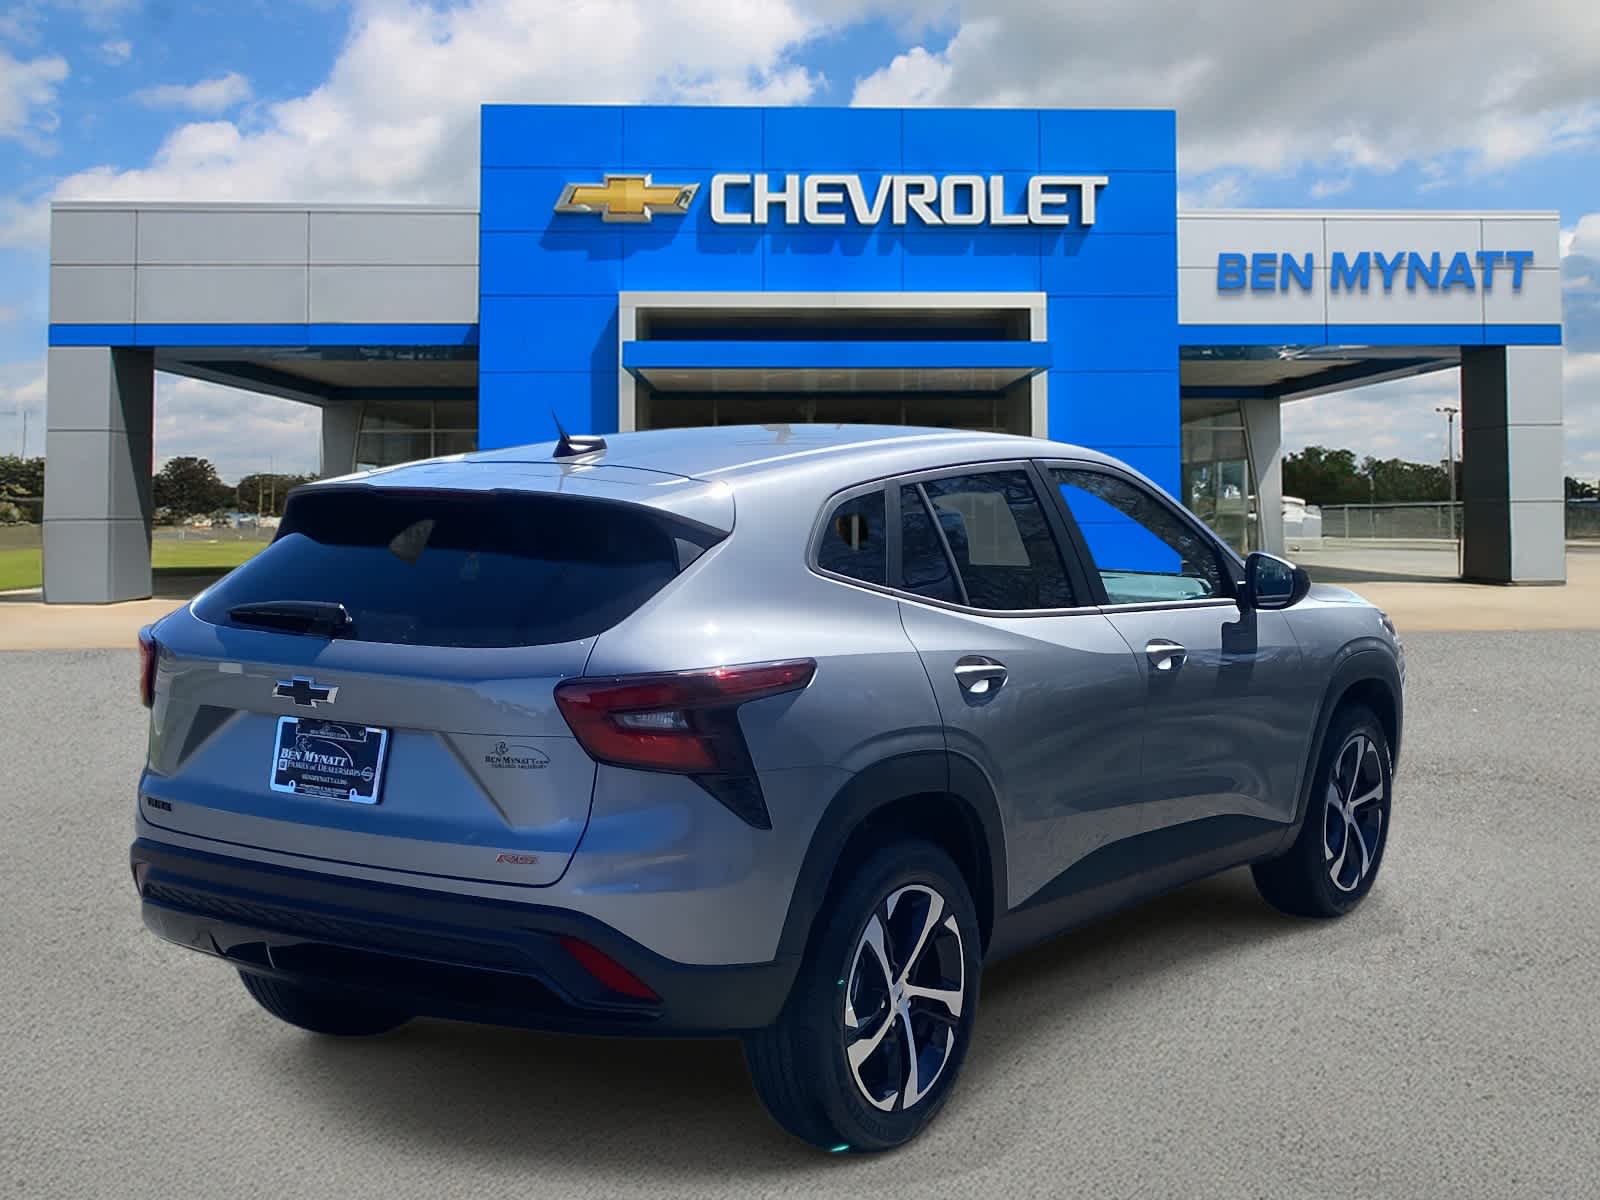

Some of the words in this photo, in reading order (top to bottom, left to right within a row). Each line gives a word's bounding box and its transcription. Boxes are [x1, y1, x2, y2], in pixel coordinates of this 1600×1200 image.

[711, 174, 1109, 225] CHEVROLET
[1217, 252, 1313, 291] BEN
[1330, 250, 1534, 291] MYNATT
[281, 748, 302, 760] BEN
[303, 751, 348, 766] MYNATT
